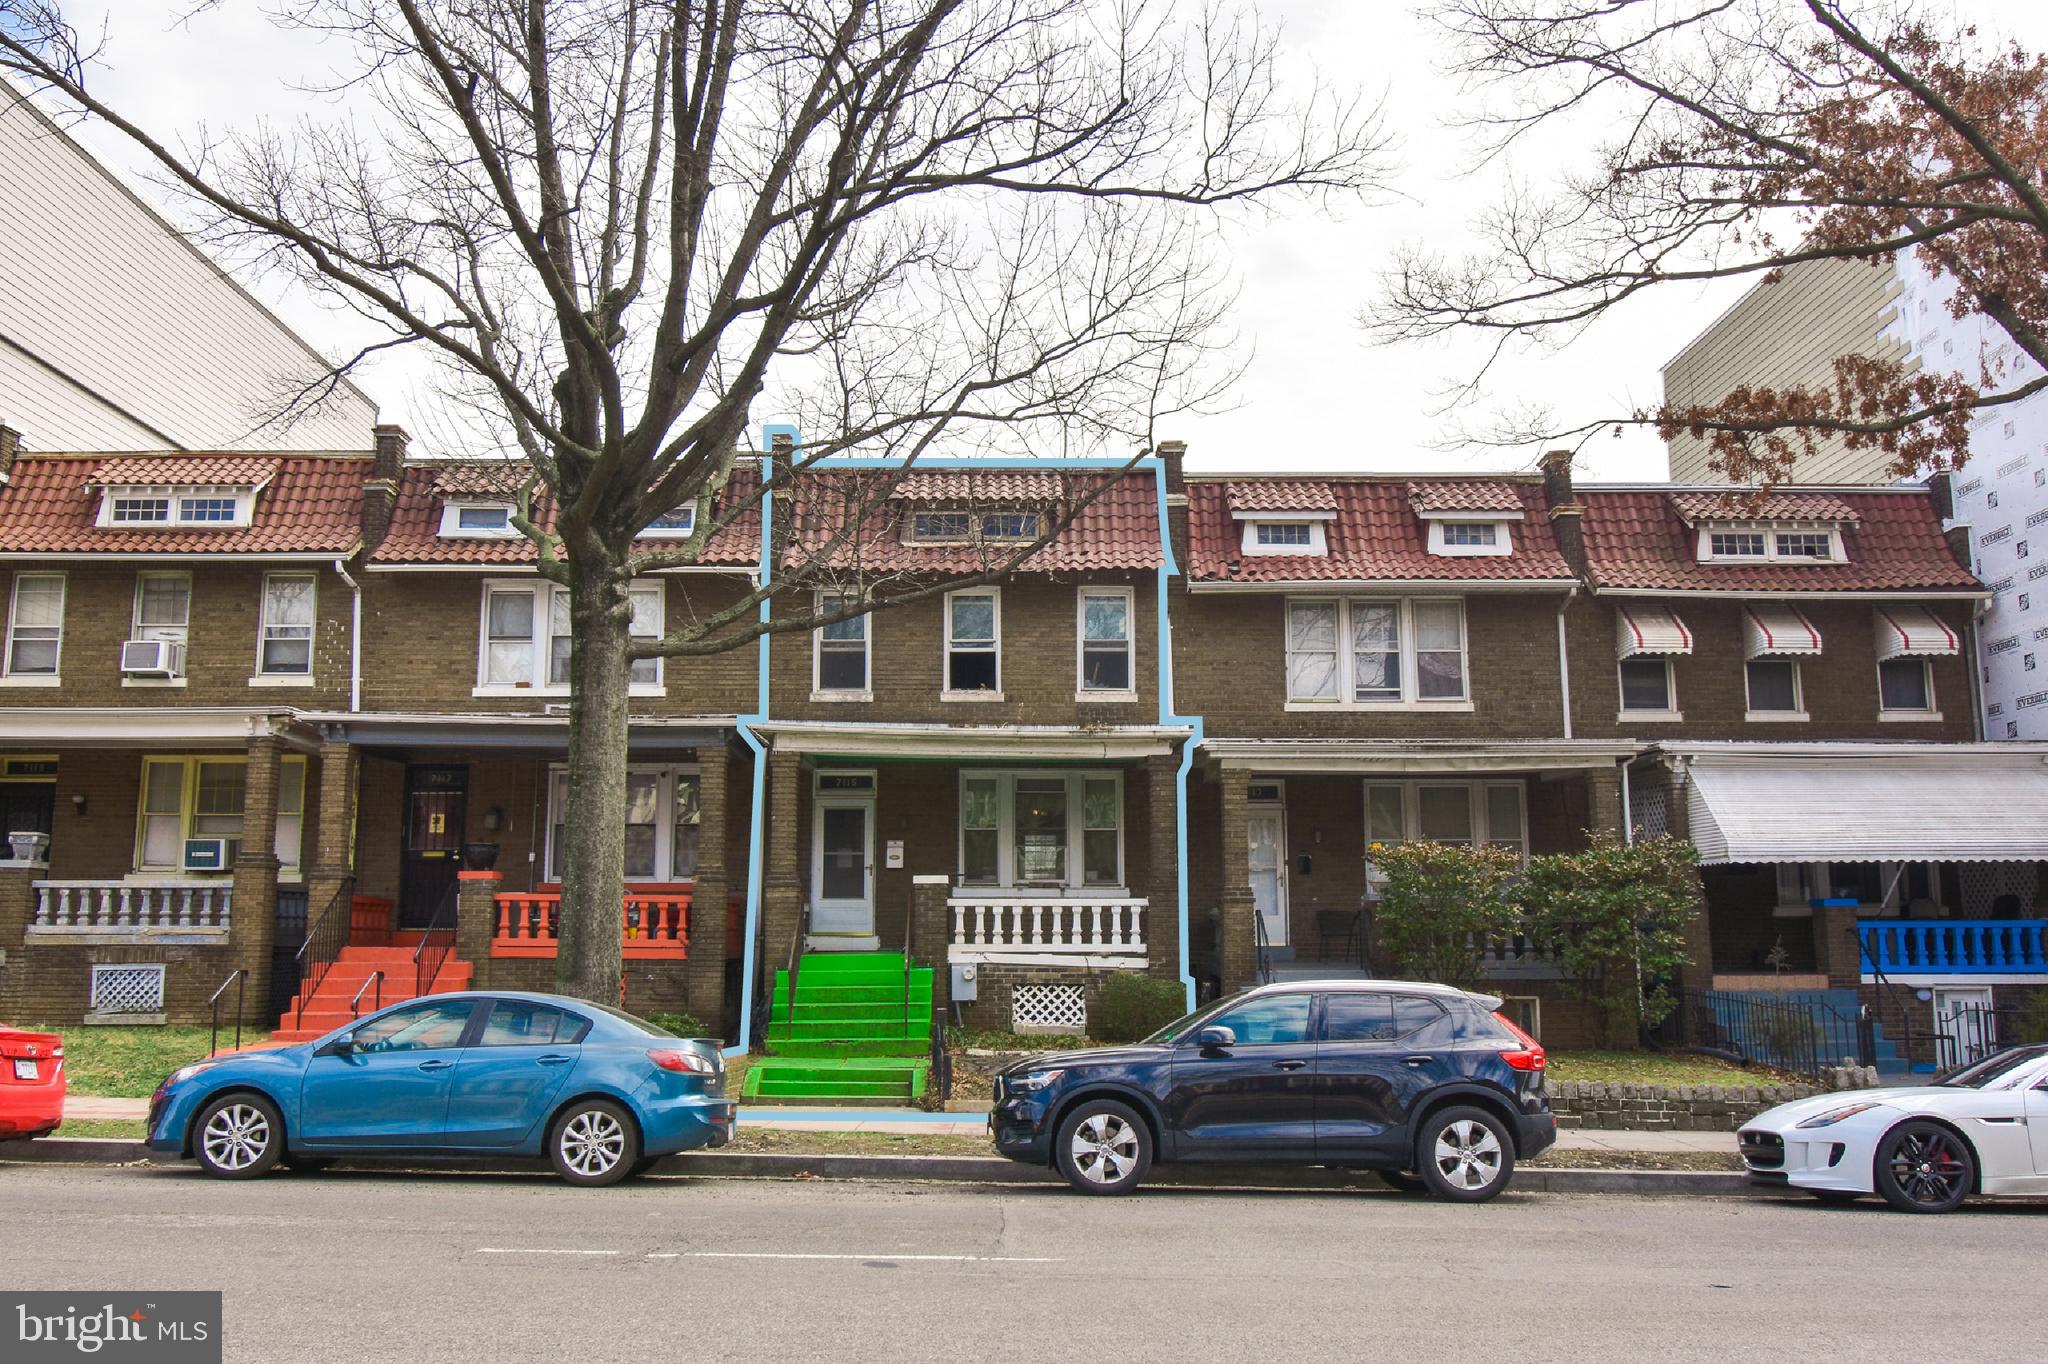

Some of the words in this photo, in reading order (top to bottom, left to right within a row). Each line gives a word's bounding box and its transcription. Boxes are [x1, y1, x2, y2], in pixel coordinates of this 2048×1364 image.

[1981, 528, 2009, 545] EVERBILT
[1988, 639, 2017, 653] EVERBILT
[2017, 693, 2048, 707] EVERBILT
